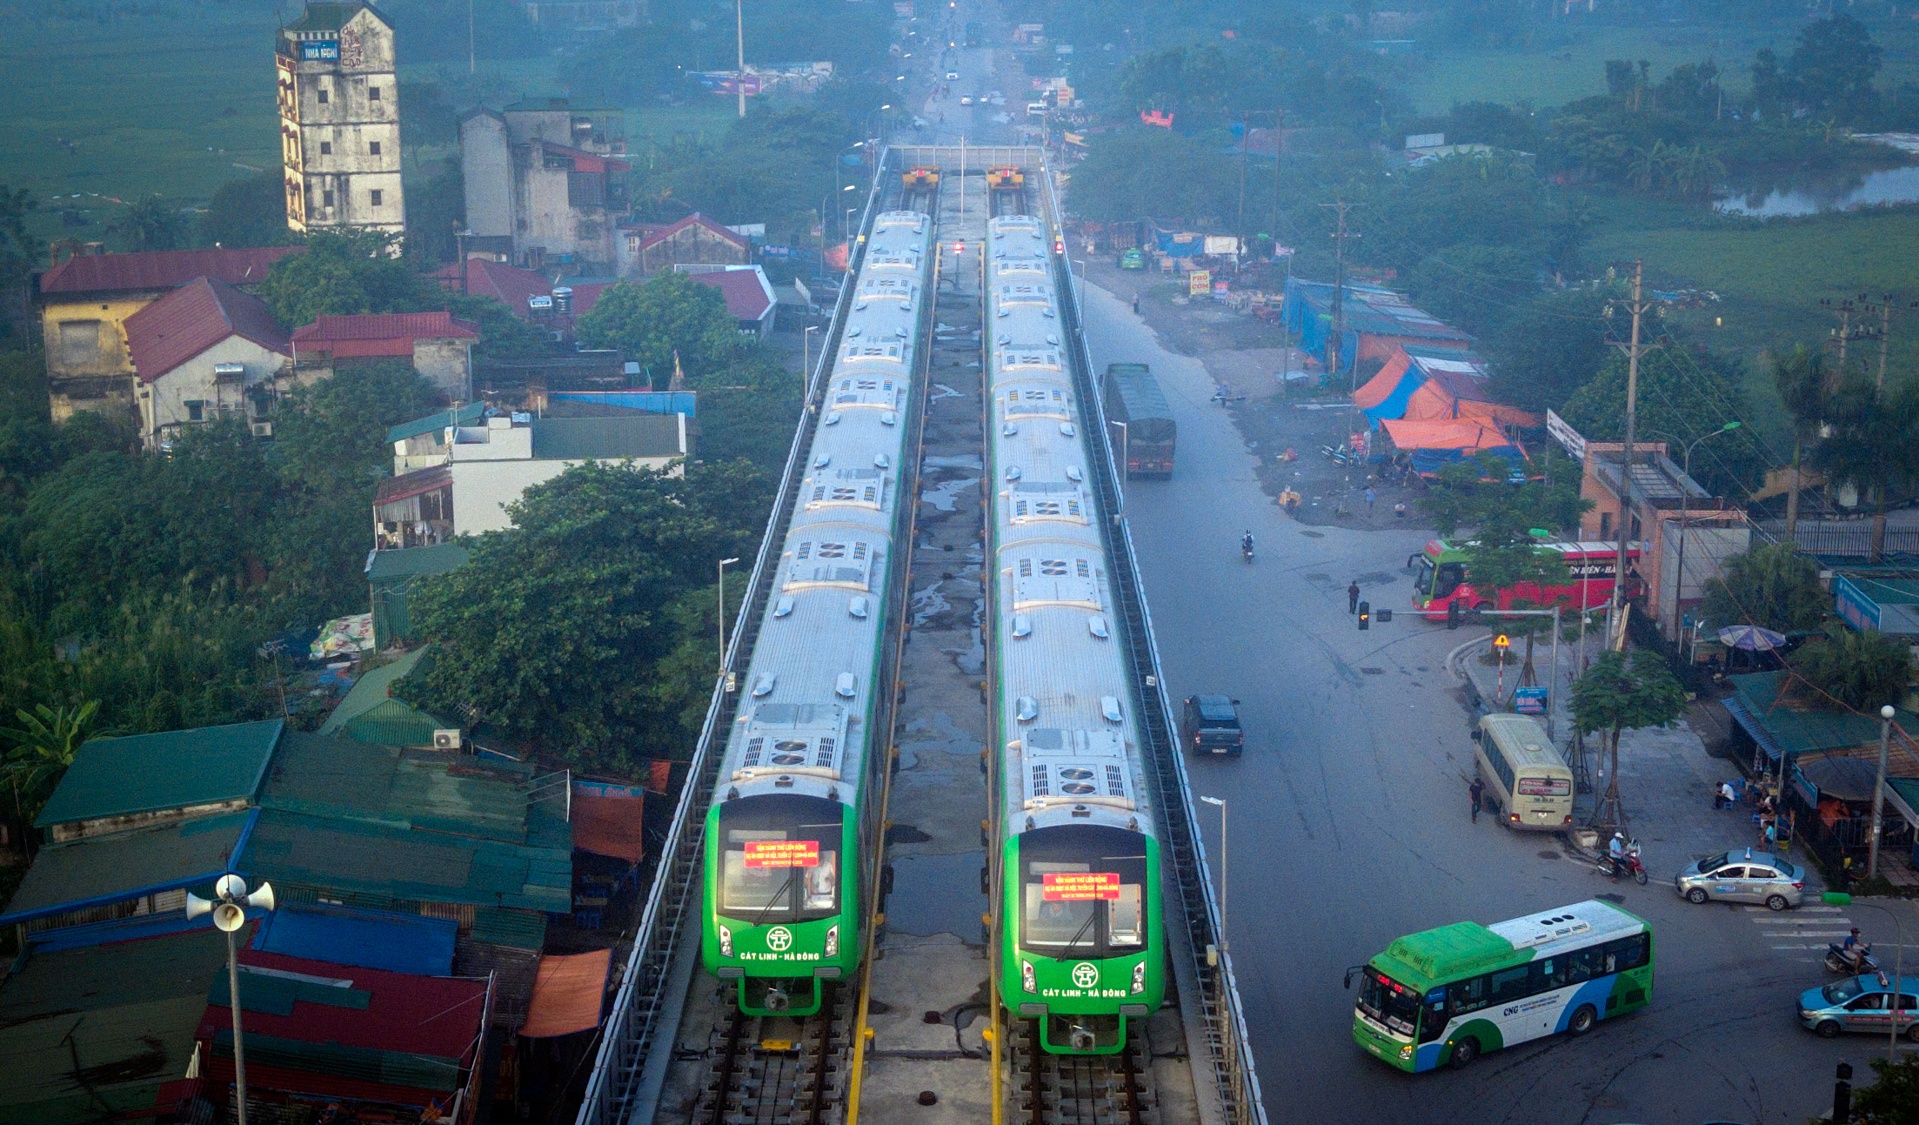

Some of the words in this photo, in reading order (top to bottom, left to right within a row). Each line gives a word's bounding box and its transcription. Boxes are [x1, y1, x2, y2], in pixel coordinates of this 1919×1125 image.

[740, 951, 756, 960] CÁT
[784, 952, 795, 960] HÀ
[796, 952, 819, 960] ĐÔNG
[1042, 988, 1059, 996] CÁT
[1062, 989, 1081, 997] LINH
[1088, 988, 1099, 997] HÀ
[1102, 988, 1126, 997] ĐÔNG
[1503, 1005, 1518, 1016] CNG
